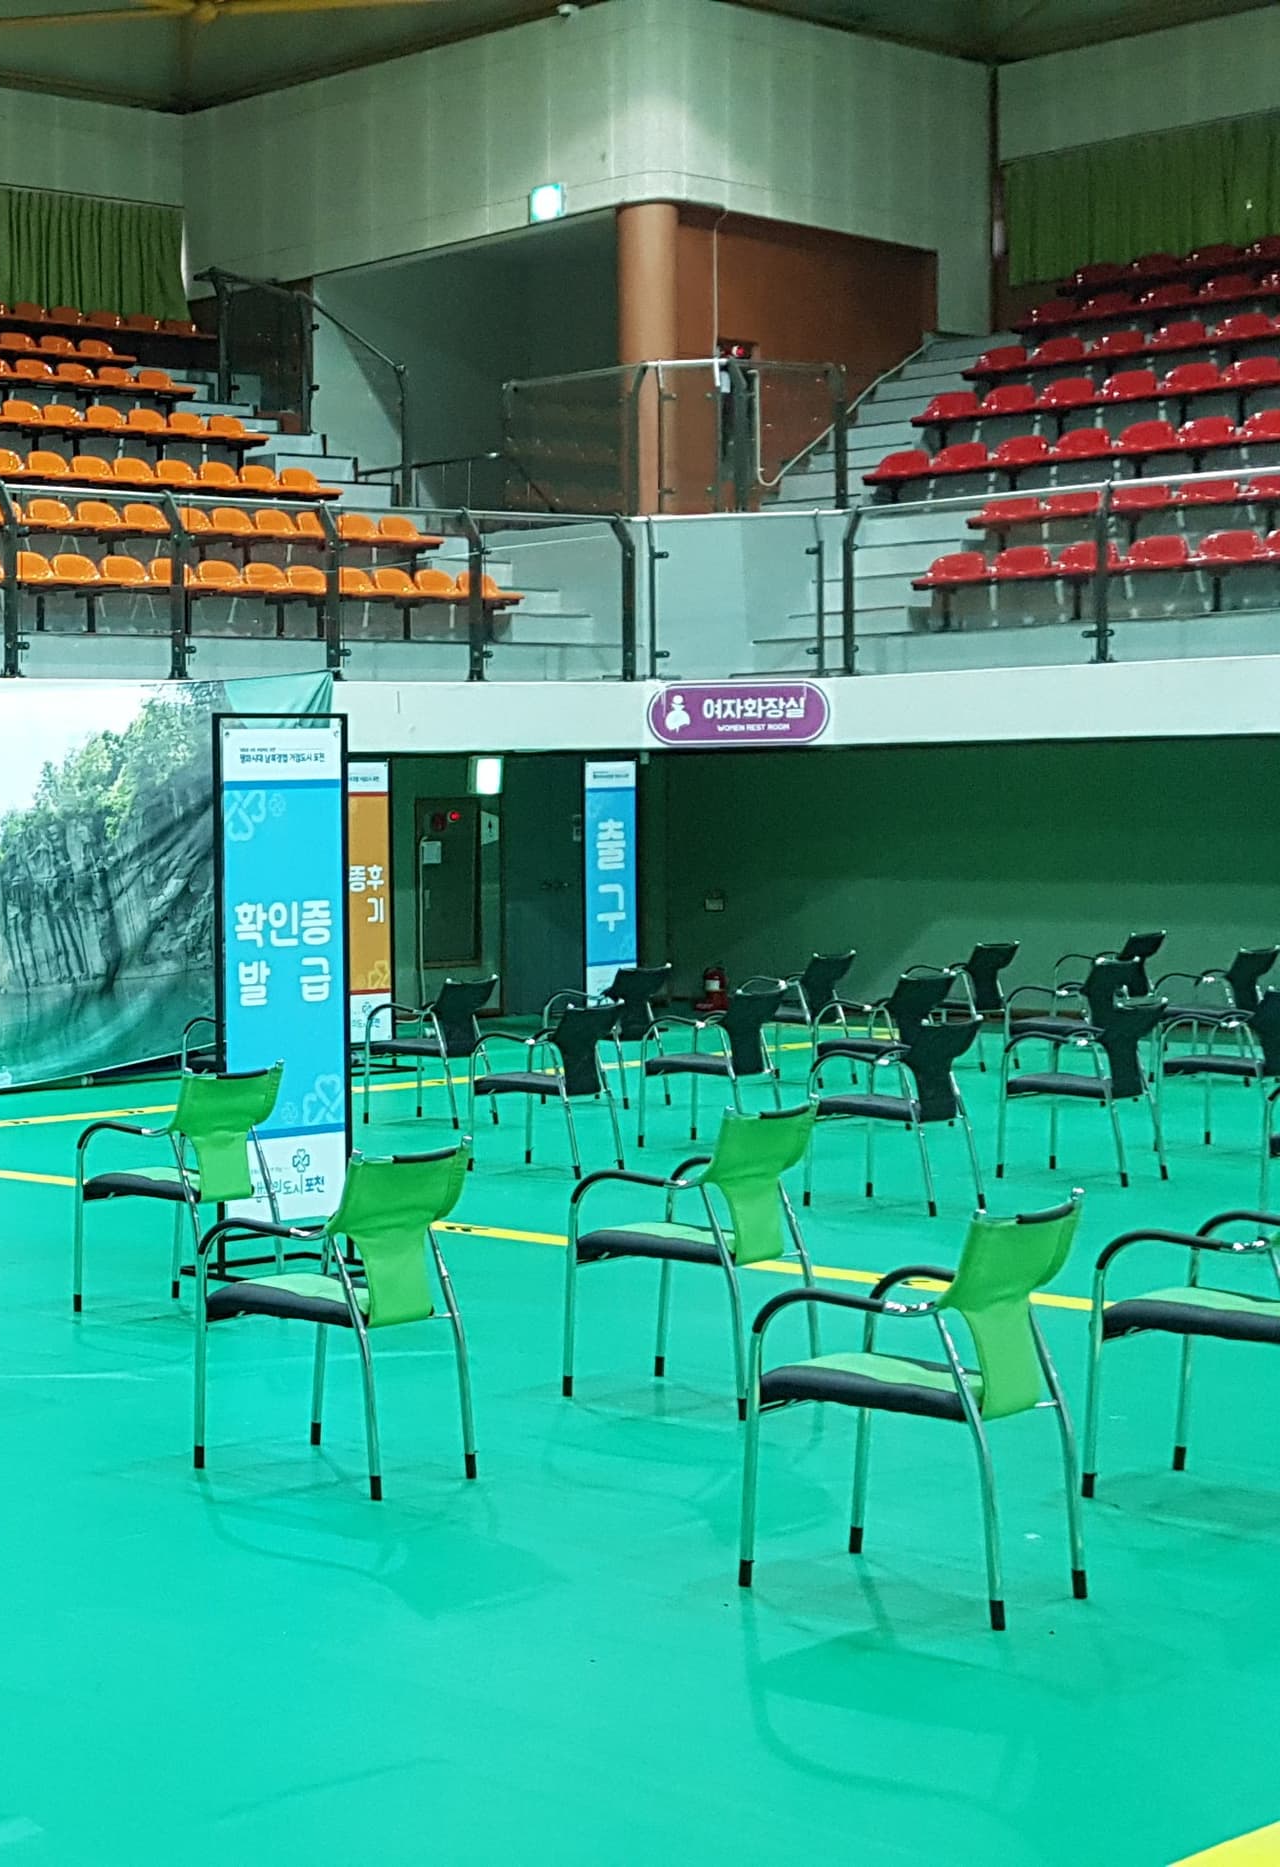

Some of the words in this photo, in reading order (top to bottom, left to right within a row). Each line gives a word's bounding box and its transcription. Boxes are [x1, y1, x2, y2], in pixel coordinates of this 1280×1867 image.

[703, 697, 805, 719] 여자화장실
[349, 864, 385, 892] 종후
[234, 900, 332, 949] 확인증
